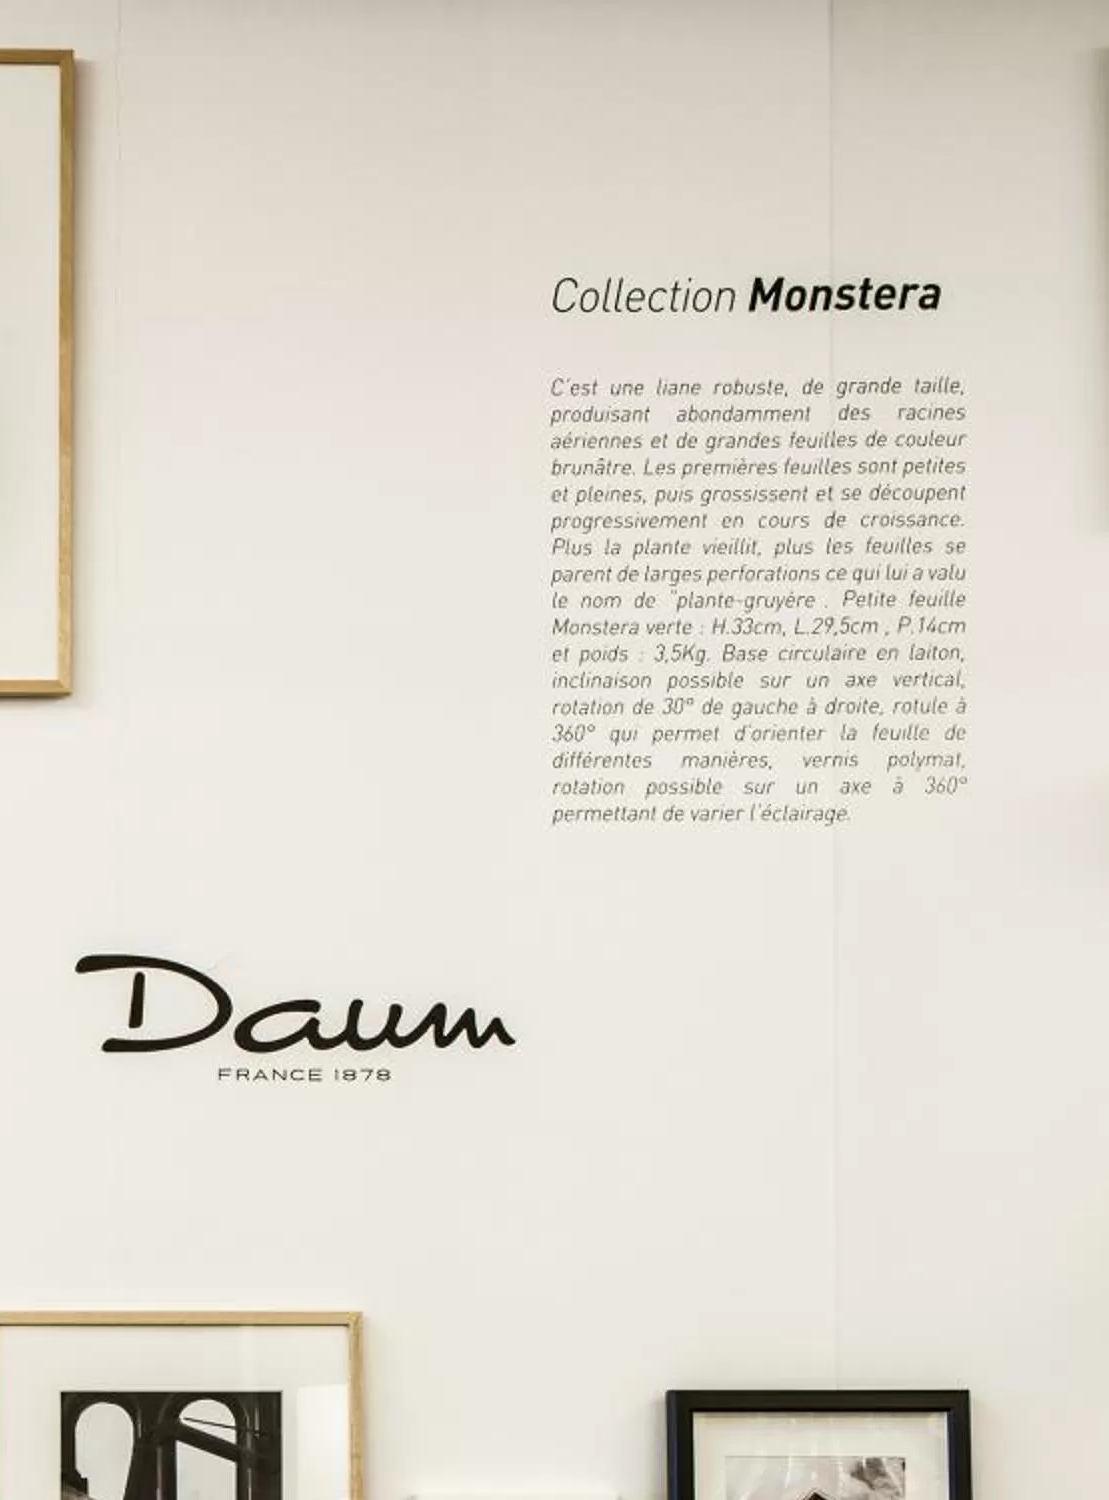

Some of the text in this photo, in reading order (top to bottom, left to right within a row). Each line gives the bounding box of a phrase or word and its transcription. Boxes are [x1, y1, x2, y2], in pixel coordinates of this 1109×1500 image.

[551, 275, 941, 313] Collection Monstera
[550, 375, 964, 399] C'est une liane robuste, de grande taille,
[549, 403, 966, 426] produisant abondamment des racines
[549, 429, 967, 454] aériennes et de grandes feuilles de couleur
[550, 483, 966, 507] et pleines, puis grossissent et se découpent
[550, 510, 964, 534] progressivement en cours de croissance.
[551, 775, 968, 800] rotation possible sur un axe à 360°
[75, 954, 516, 1054] Daum
[217, 1067, 393, 1082] FRANCE 1878
